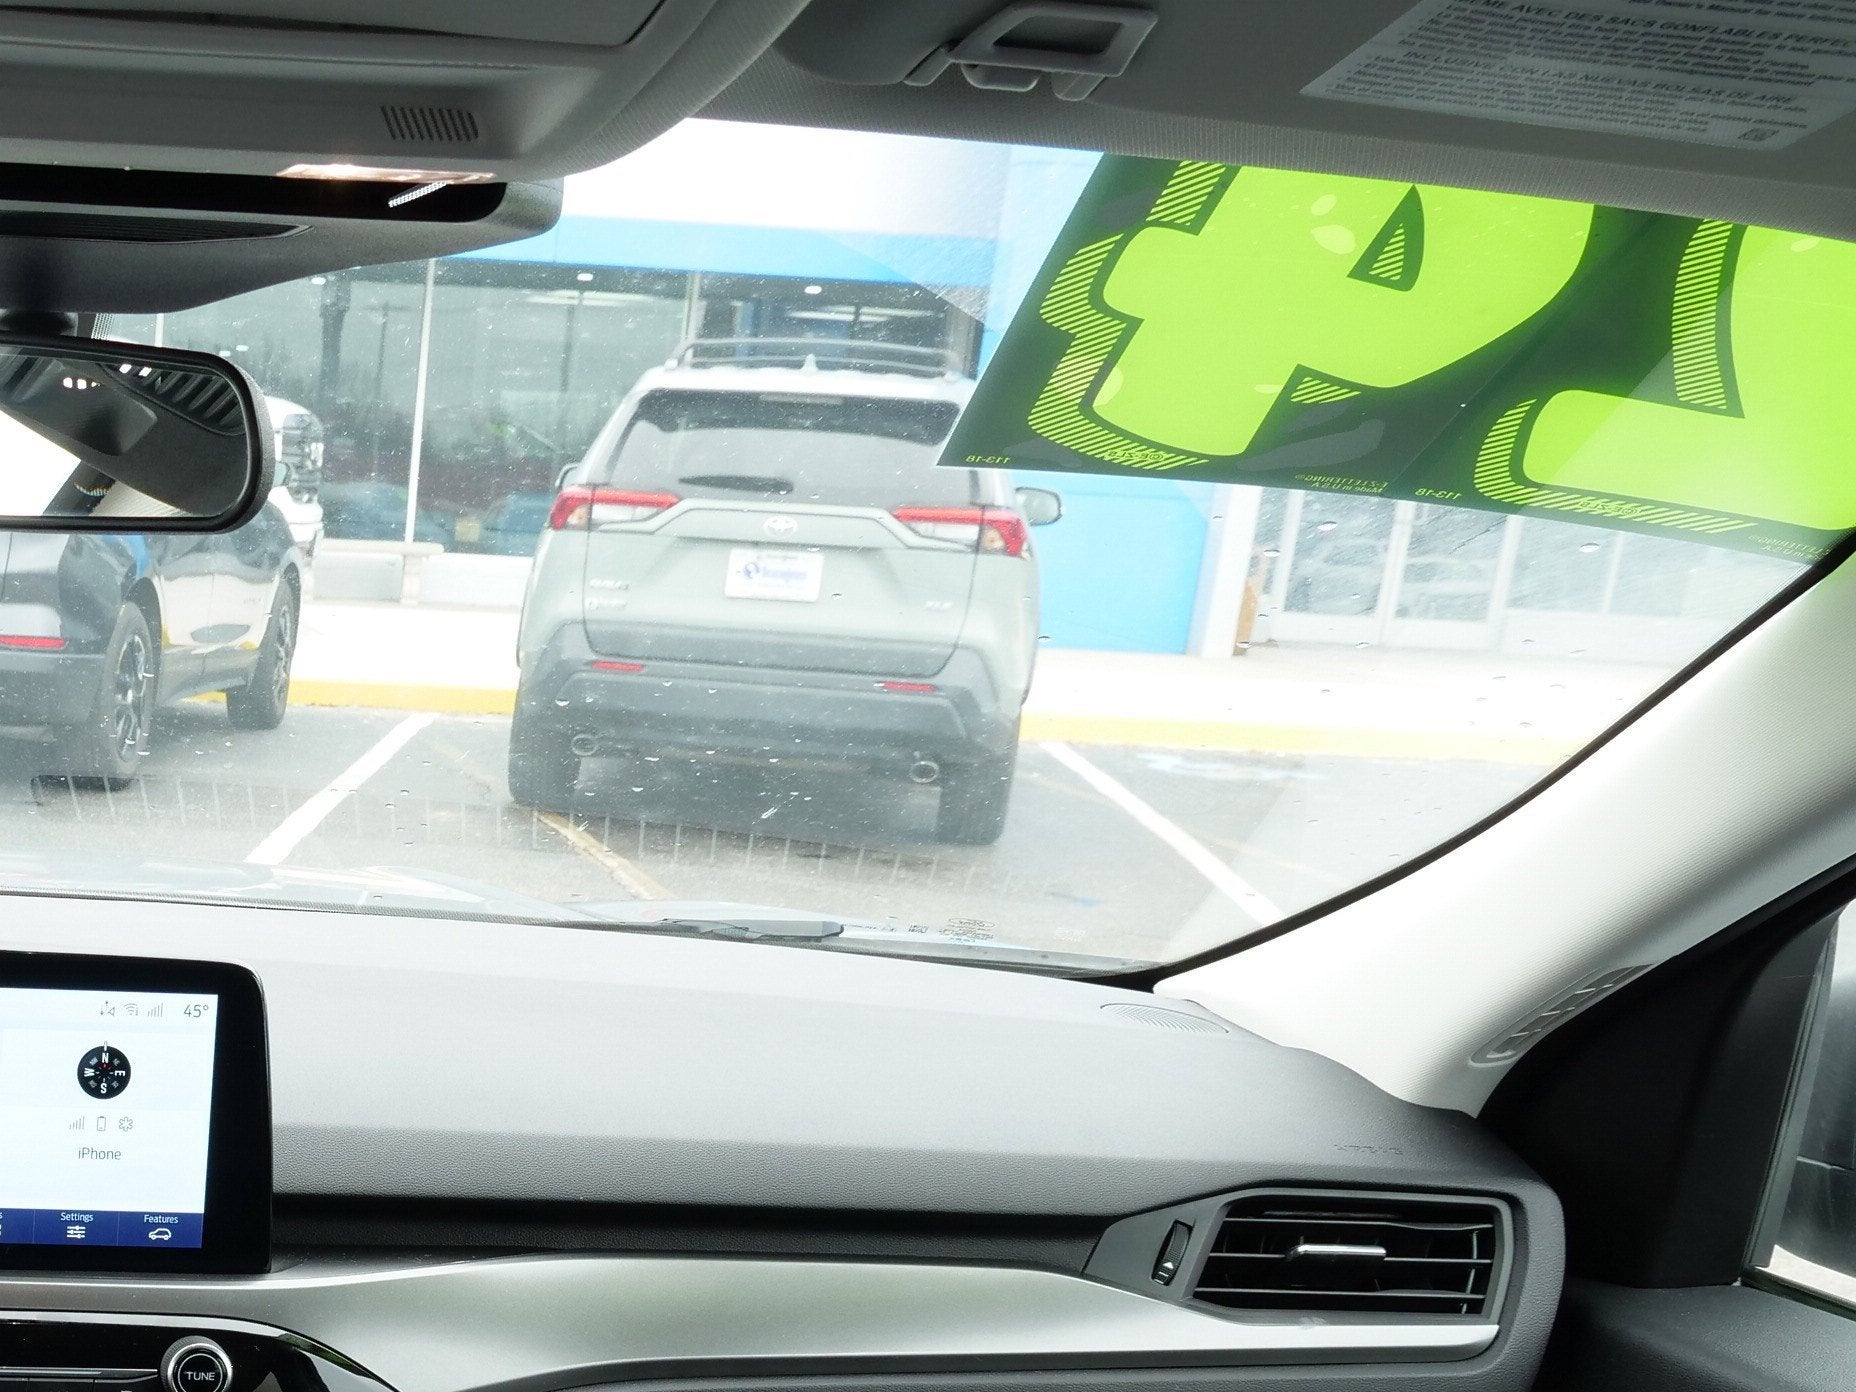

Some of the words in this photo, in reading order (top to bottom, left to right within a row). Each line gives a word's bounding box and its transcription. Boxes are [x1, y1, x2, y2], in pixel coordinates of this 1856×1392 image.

[1511, 4, 1558, 17] AVEC
[1564, 11, 1604, 21] DES
[183, 1004, 209, 1018] 45°
[101, 1052, 109, 1063] N
[100, 1083, 107, 1093] S
[78, 1147, 122, 1160] iPhone
[61, 1212, 94, 1223] Settings
[144, 1214, 179, 1224] Features
[186, 1371, 216, 1381] TUNE
